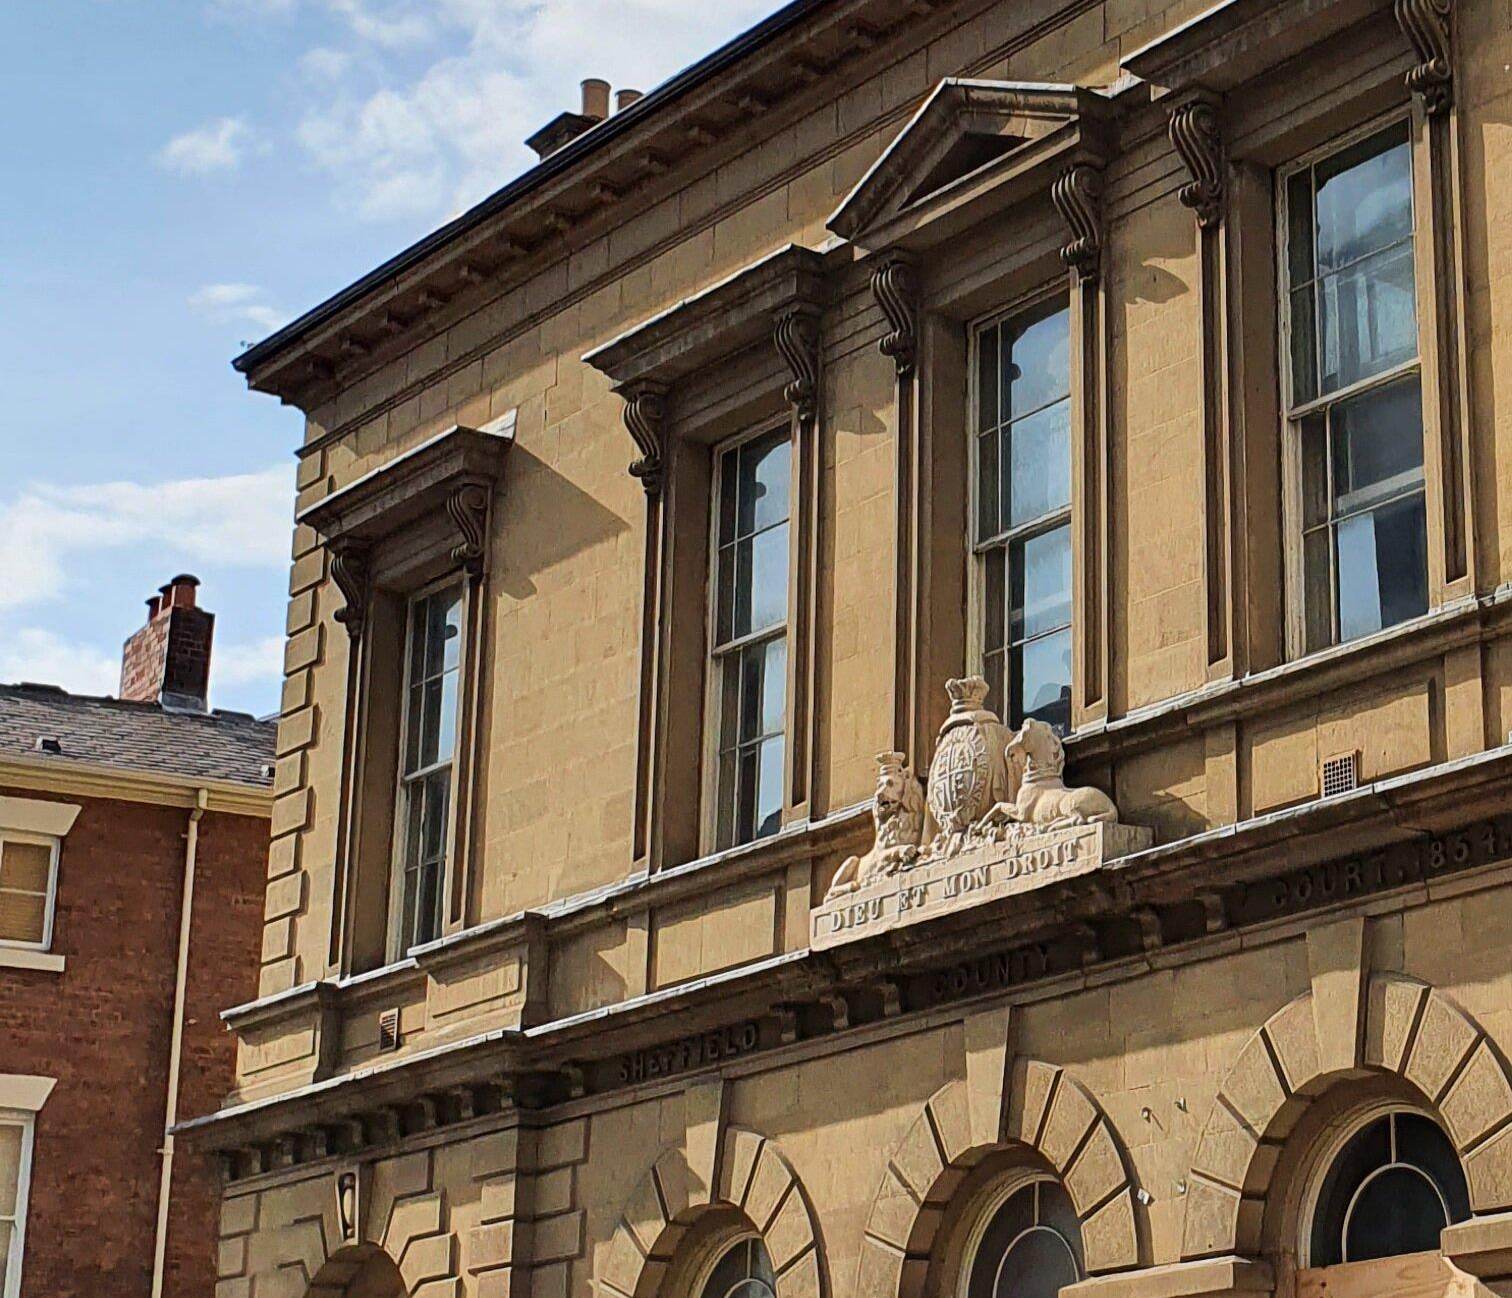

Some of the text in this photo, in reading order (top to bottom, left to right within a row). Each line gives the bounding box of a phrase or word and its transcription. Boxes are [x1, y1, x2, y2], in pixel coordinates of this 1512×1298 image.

[829, 837, 1078, 933] DIEU ET MON DROIT
